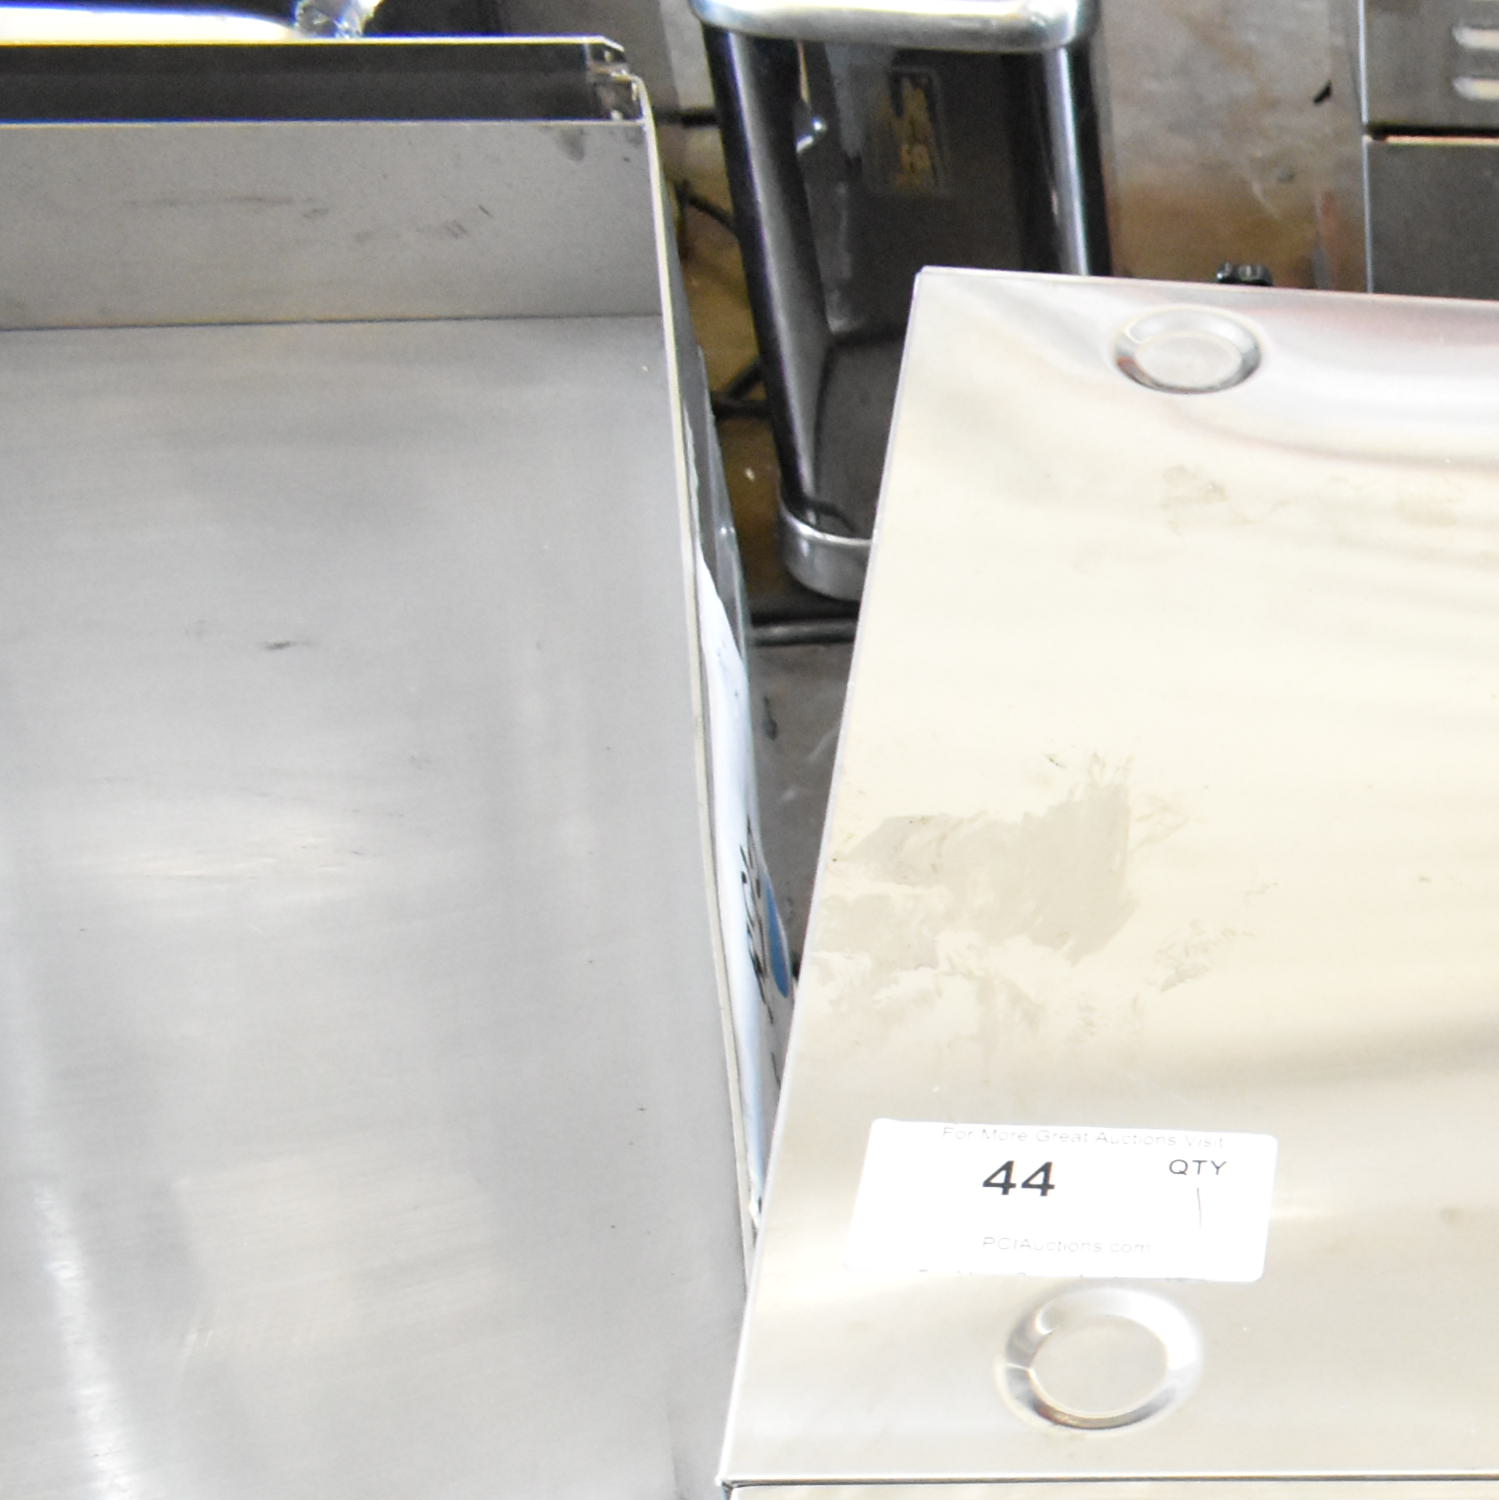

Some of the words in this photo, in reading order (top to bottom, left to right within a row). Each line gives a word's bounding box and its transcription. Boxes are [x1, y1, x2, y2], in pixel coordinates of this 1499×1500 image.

[942, 1125, 973, 1141] For
[980, 1127, 1029, 1143] More
[1035, 1129, 1090, 1144] Great
[1096, 1131, 1177, 1147] Auctions
[1184, 1135, 1224, 1149] Visit
[983, 1161, 1054, 1196] 44
[1168, 1158, 1228, 1176] QTY
